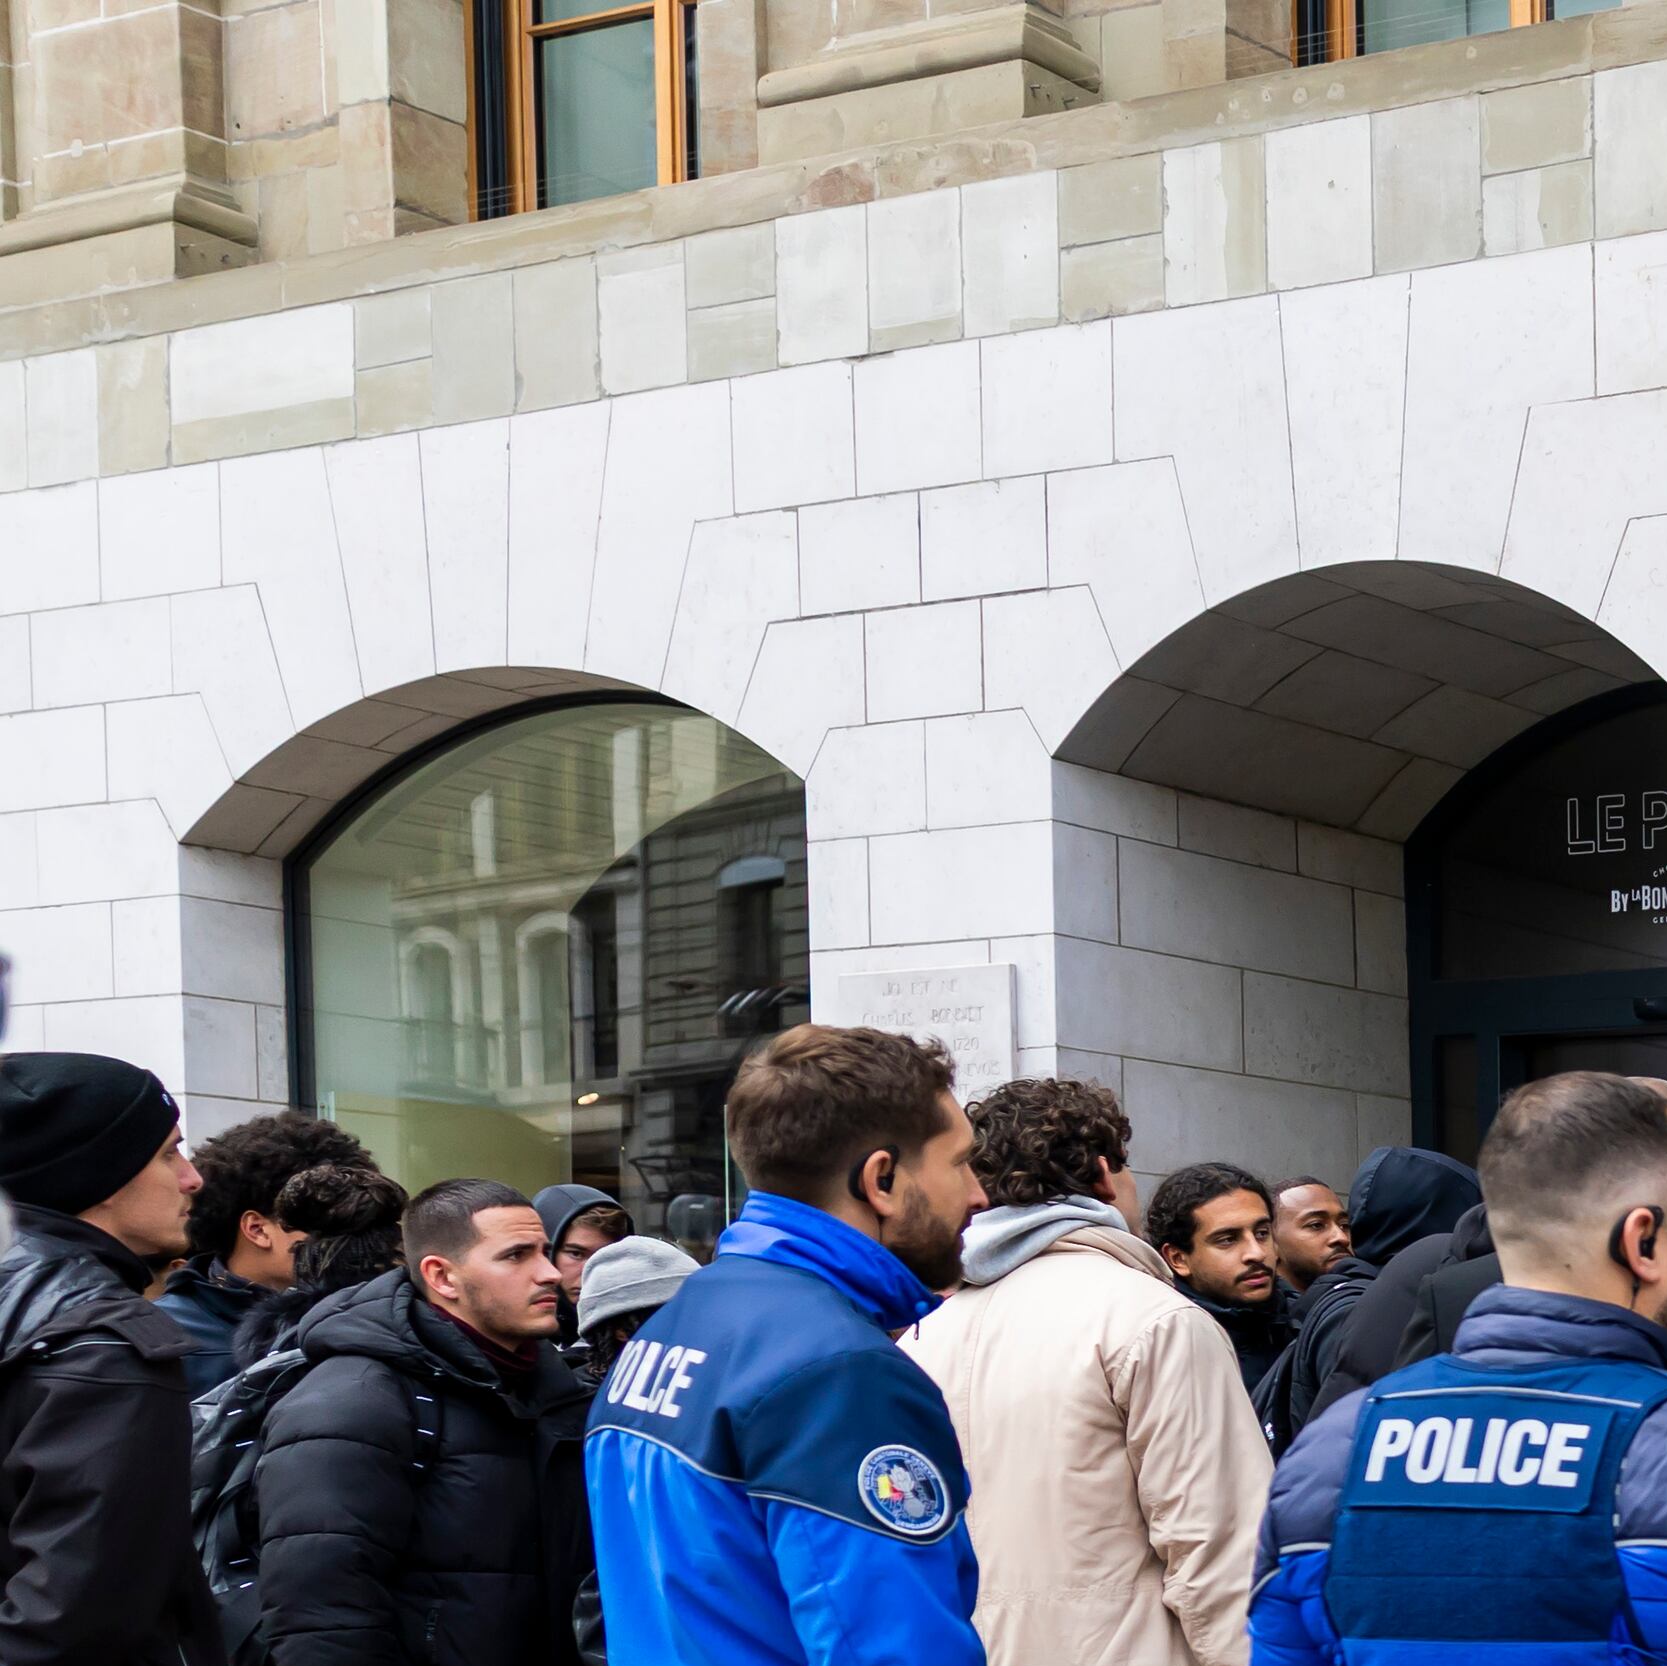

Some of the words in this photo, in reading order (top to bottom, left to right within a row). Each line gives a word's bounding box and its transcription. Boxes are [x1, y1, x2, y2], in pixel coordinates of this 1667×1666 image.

[1567, 794, 1626, 855] LE
[953, 1037, 980, 1051] 1720
[1365, 1416, 1590, 1488] POLICE
